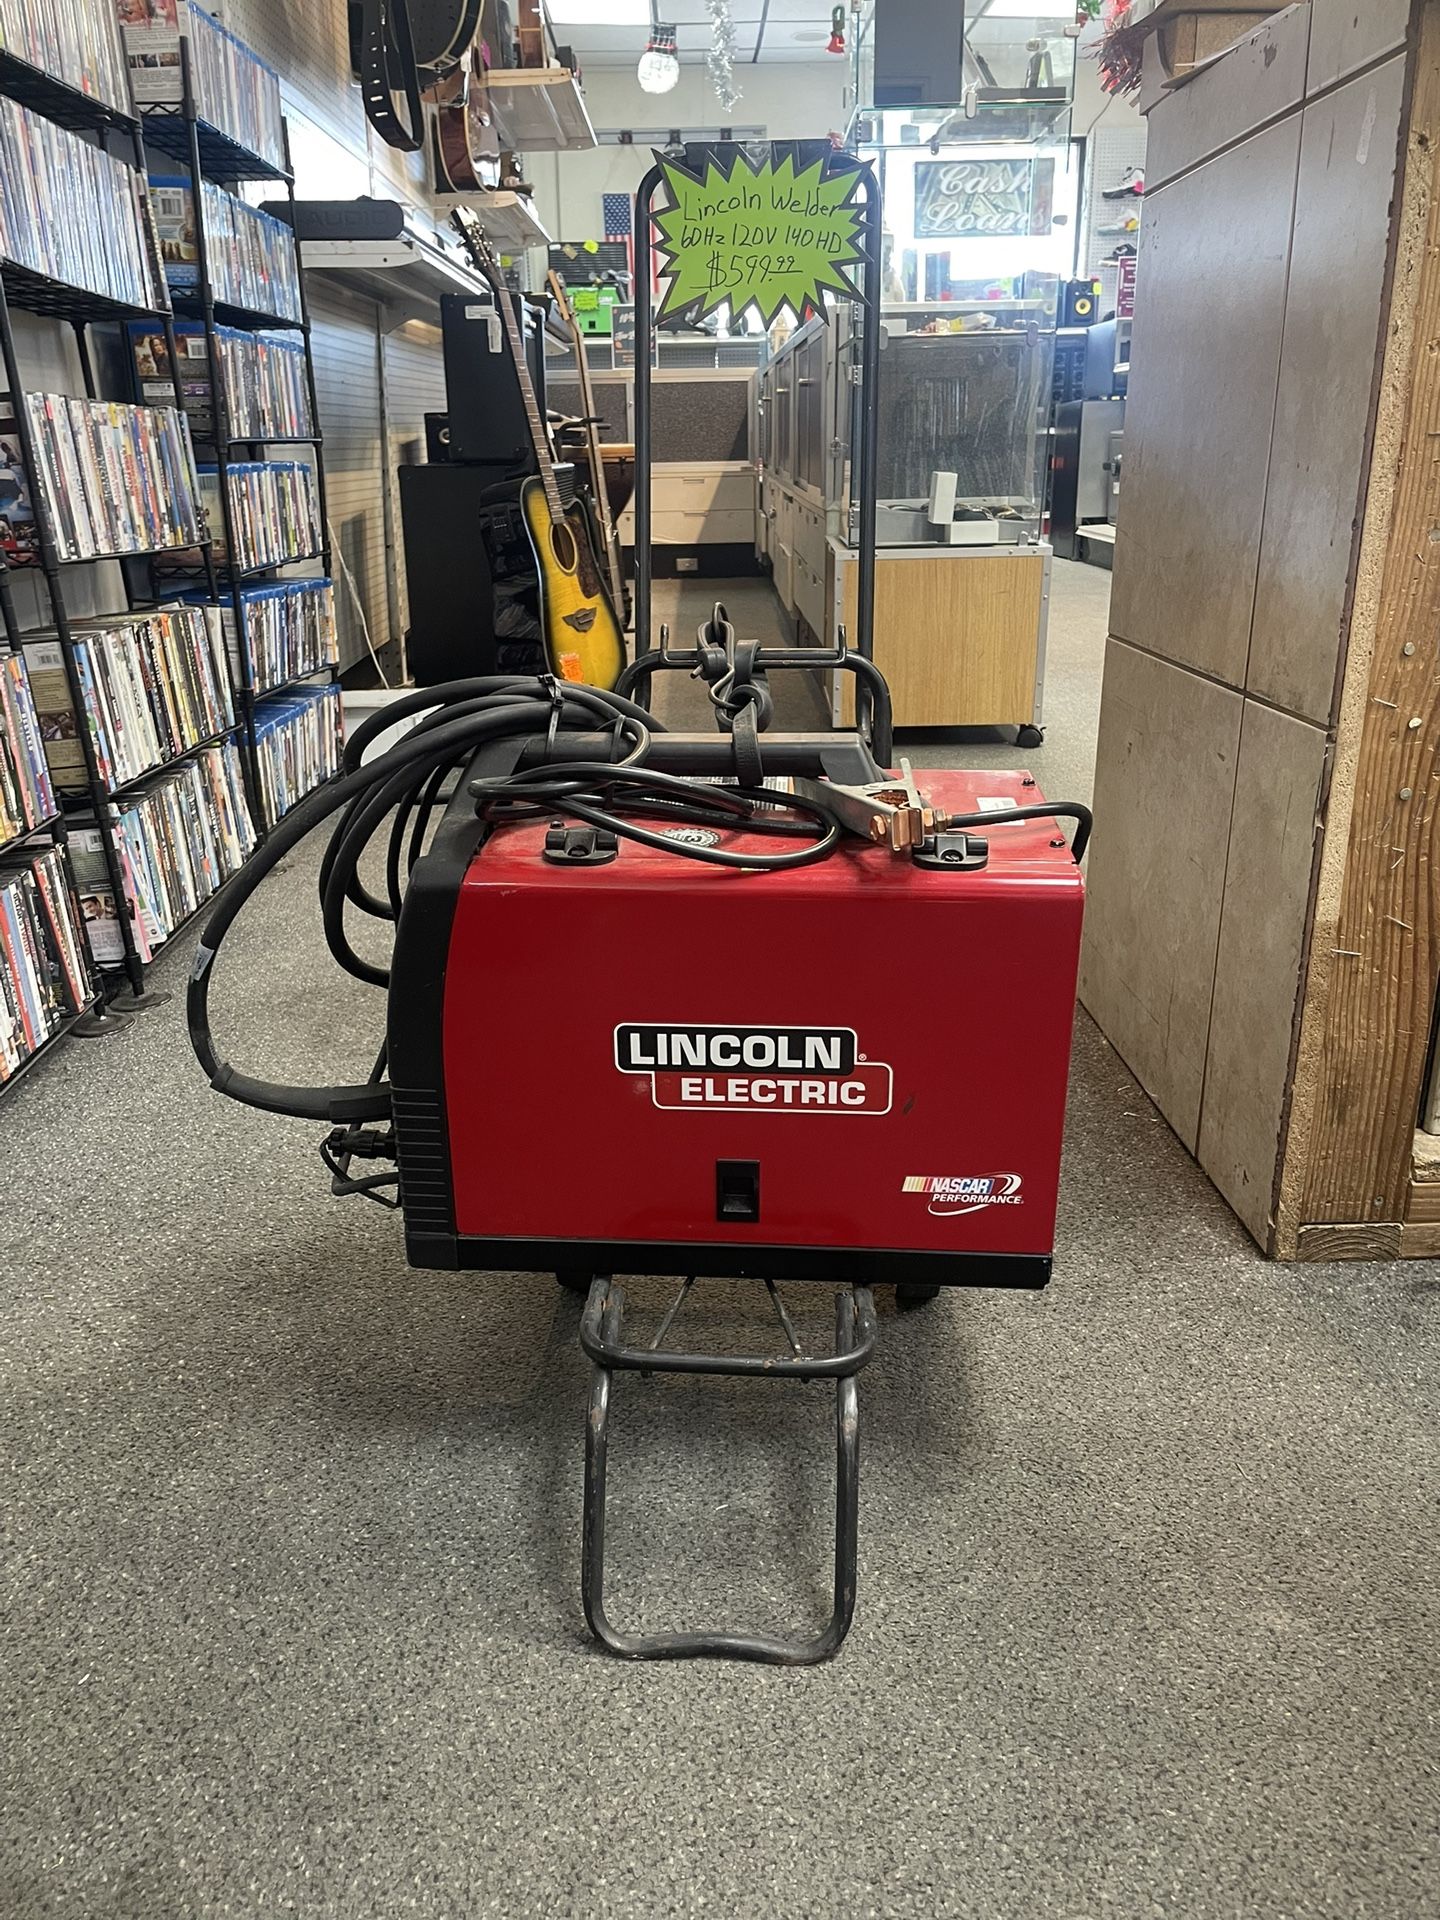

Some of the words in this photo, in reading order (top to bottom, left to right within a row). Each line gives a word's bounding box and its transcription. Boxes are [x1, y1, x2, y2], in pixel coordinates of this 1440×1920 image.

[938, 164, 1031, 196] Cash
[683, 185, 761, 222] Lincoln
[771, 185, 841, 219] Welder
[920, 201, 1050, 233] Loans
[680, 224, 726, 249] 60Hz
[732, 223, 777, 247] 120V
[705, 250, 803, 292] $599.99
[629, 1032, 841, 1070] LINCOLN
[680, 1076, 867, 1106] ELECTRIC
[930, 1177, 991, 1195] NASCAR
[932, 1193, 1023, 1205] PERFORMANCE
